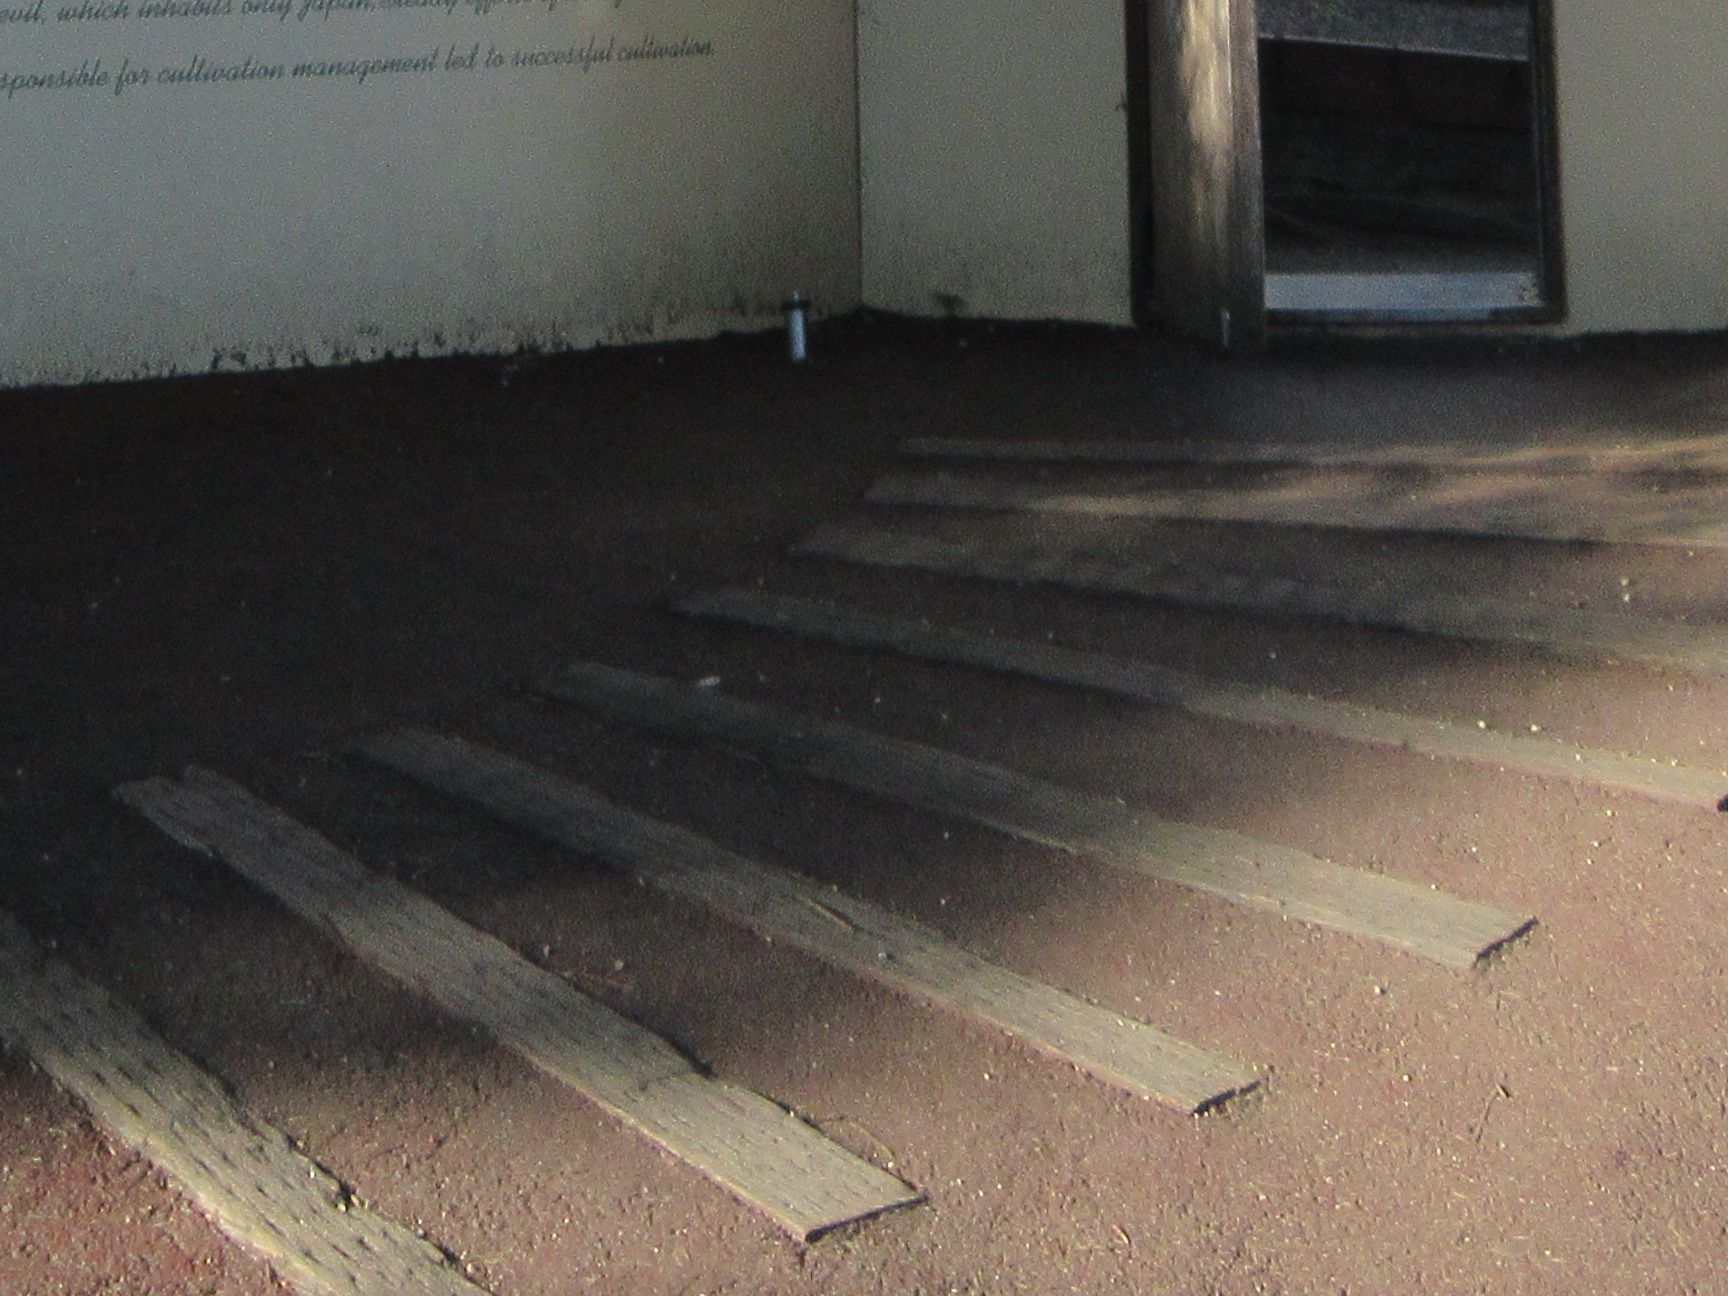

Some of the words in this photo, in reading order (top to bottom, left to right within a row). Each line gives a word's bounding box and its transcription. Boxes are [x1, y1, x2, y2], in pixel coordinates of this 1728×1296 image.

[114, 58, 150, 96] for
[156, 54, 285, 84] cultivation
[292, 44, 440, 85] management
[443, 43, 479, 71] led
[485, 43, 505, 68] to
[510, 36, 615, 75] successful
